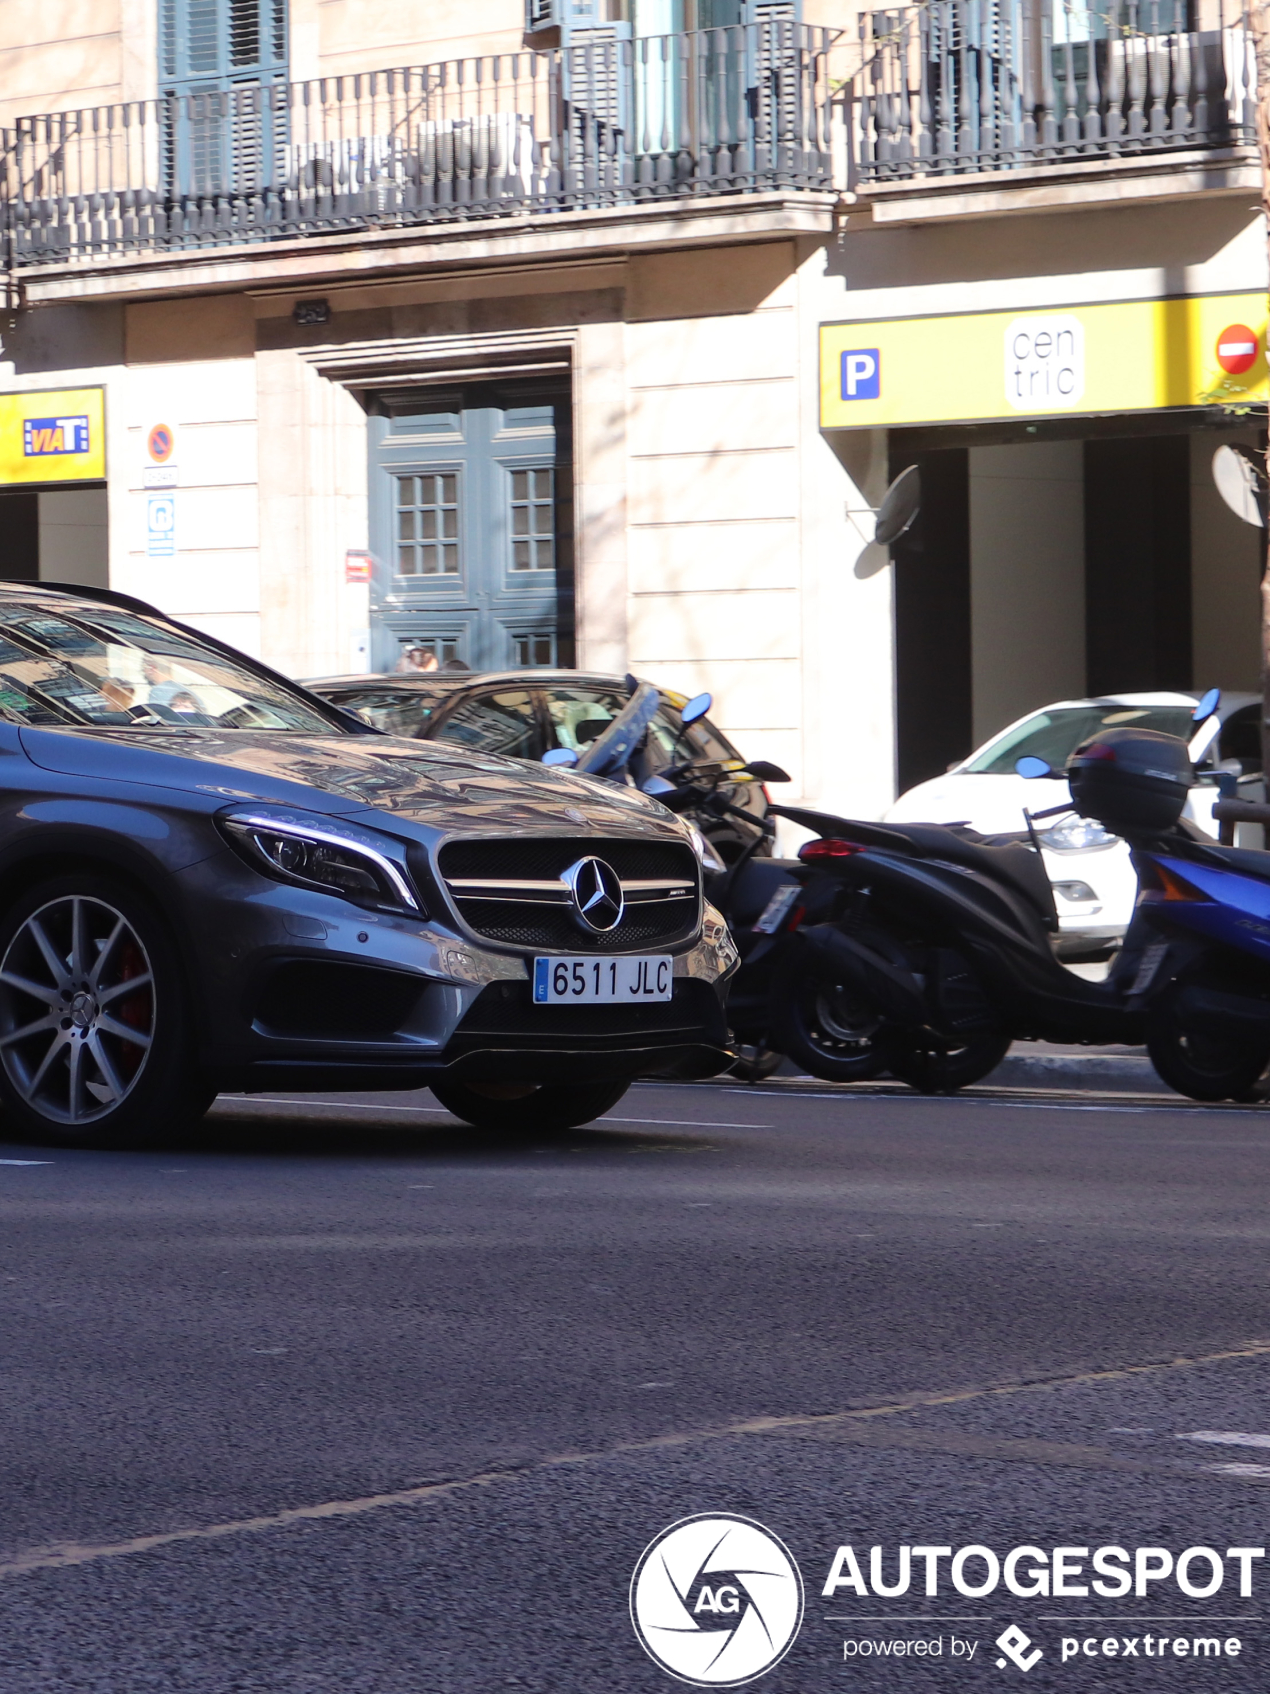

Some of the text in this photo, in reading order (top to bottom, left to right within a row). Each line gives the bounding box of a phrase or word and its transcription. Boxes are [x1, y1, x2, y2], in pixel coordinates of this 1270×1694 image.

[1012, 327, 1075, 361] cen
[845, 353, 876, 396] P
[1013, 361, 1075, 398] tric
[553, 961, 668, 996] 6511 JLC
